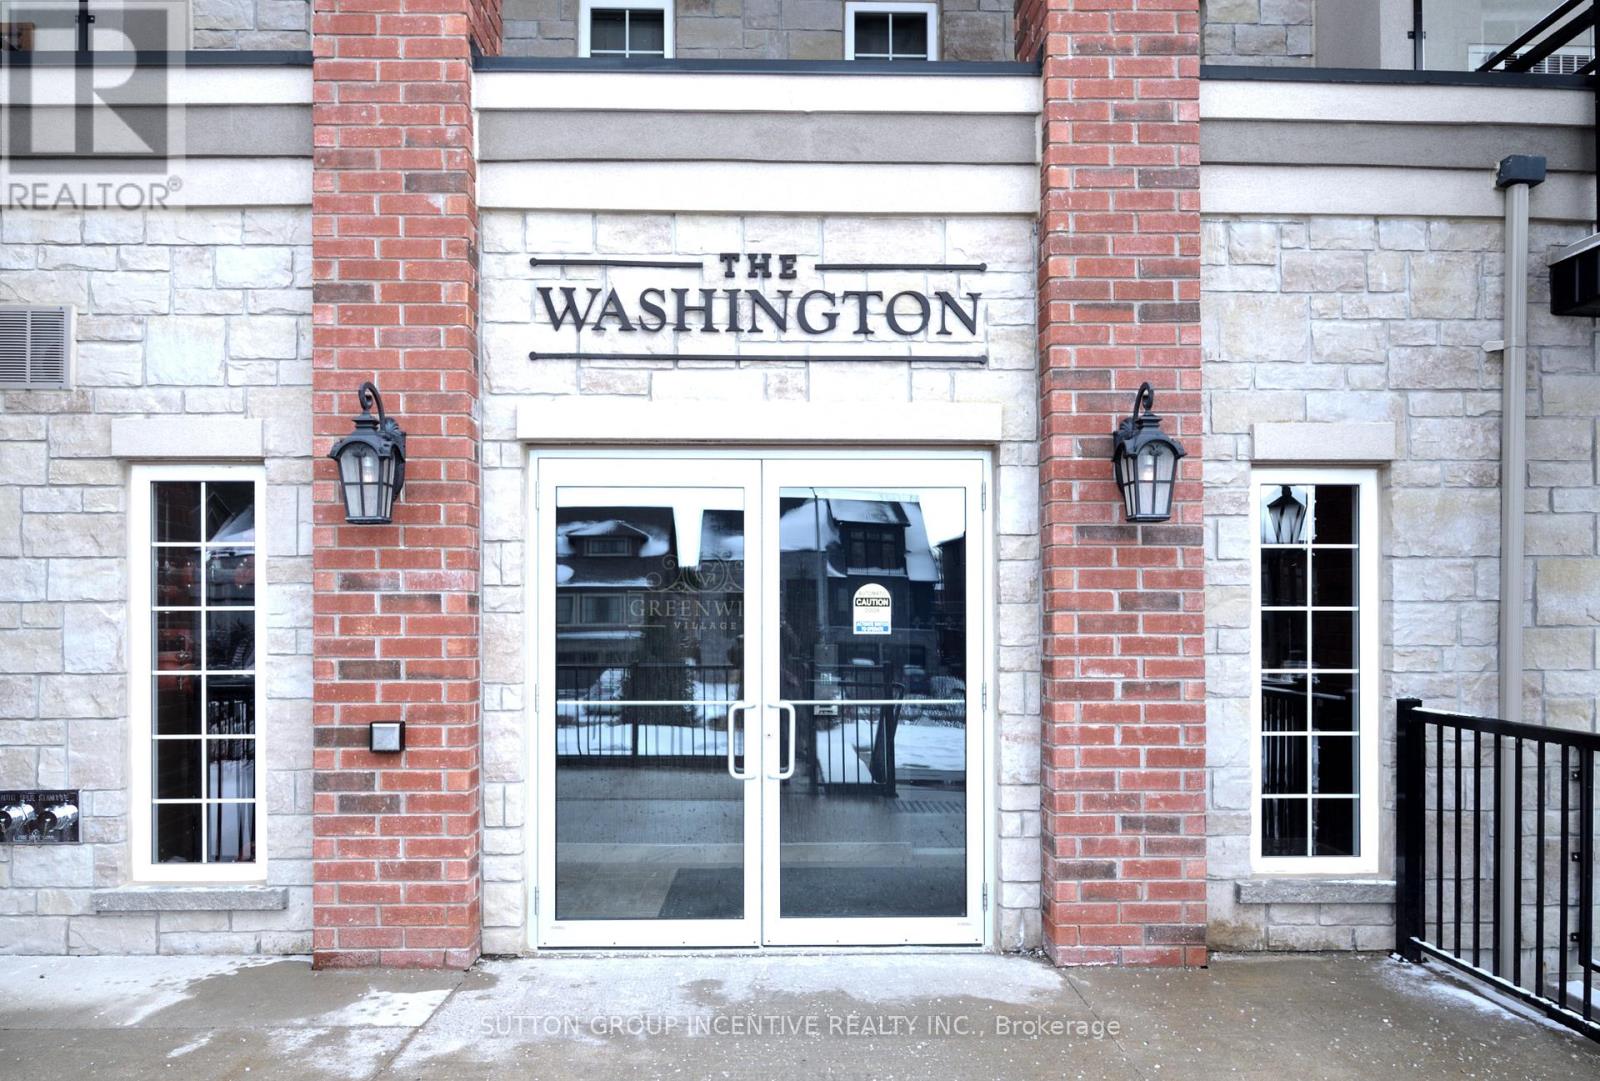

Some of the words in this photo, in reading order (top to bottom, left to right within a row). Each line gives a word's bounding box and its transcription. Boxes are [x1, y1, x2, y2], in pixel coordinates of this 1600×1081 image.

[719, 252, 798, 280] THE
[536, 286, 983, 336] WASHINGTON
[856, 598, 889, 606] CAUTION
[673, 621, 737, 630] VILLAGE
